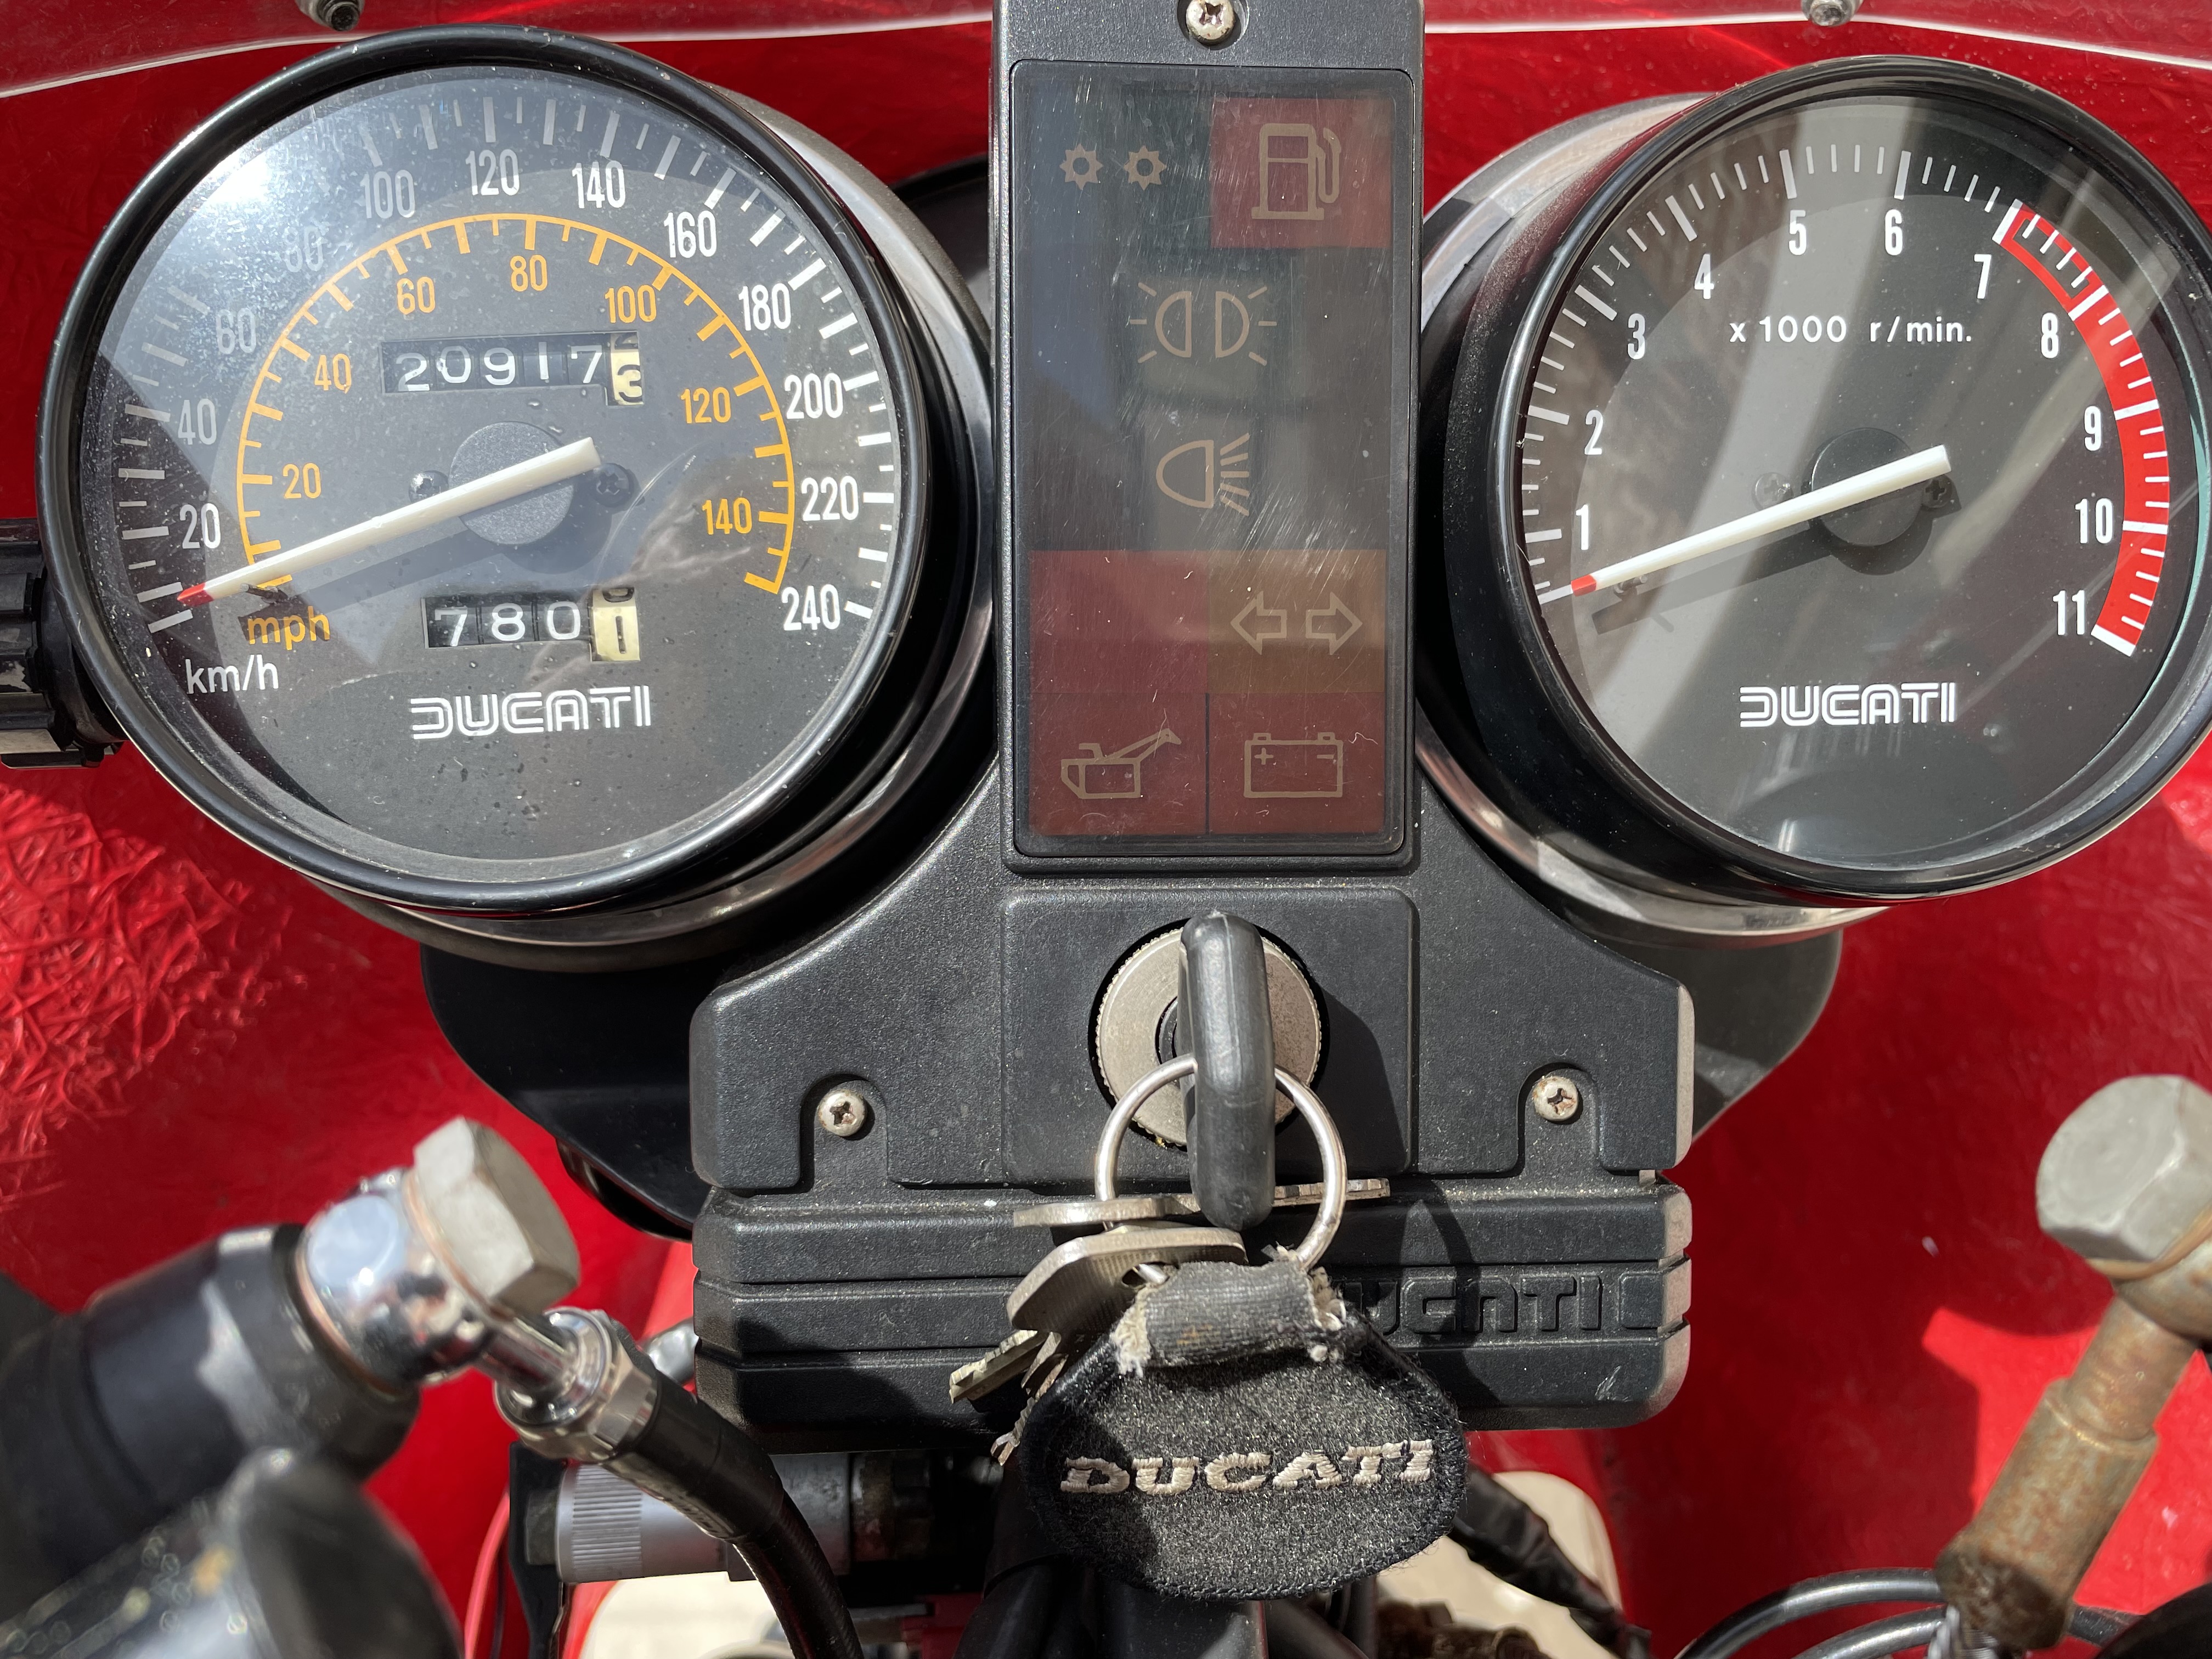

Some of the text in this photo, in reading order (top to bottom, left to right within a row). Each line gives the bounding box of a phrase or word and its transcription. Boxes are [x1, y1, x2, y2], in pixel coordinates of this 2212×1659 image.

[360, 169, 416, 219] 100
[466, 149, 520, 196] 120
[572, 160, 626, 208] 140
[284, 225, 325, 273] 80
[664, 210, 718, 258] 160
[1788, 210, 1807, 256] 5
[1884, 208, 1904, 256] 6
[397, 276, 436, 315] 60
[510, 255, 548, 292] 80
[1694, 253, 1714, 300] 4
[1973, 253, 1992, 300] 7
[605, 284, 657, 324] 100
[738, 283, 792, 331] 180
[216, 308, 257, 354] 60
[1627, 313, 1646, 360] 3
[1729, 322, 1747, 343] x
[1758, 315, 1847, 343] 1000
[2040, 313, 2060, 359] 8
[314, 353, 352, 391] 40
[680, 387, 731, 424] 120
[783, 373, 845, 420] 200
[177, 398, 217, 445] 40
[1584, 410, 1604, 455] 2
[2083, 405, 2102, 452] 9
[282, 462, 323, 499] 20
[800, 475, 860, 522] 220
[179, 503, 221, 549] 20
[702, 497, 753, 535] 140
[1575, 504, 1590, 551] 1
[2074, 498, 2115, 544] 10
[247, 606, 331, 651] mph
[781, 584, 841, 631] 240
[2052, 590, 2086, 636] 11
[184, 653, 279, 695] km/h
[410, 685, 652, 741] DUCATI
[1739, 682, 1957, 729] DUCATI
[1343, 1275, 1603, 1336] UCATI
[1060, 1438, 1434, 1496] DUCATI
